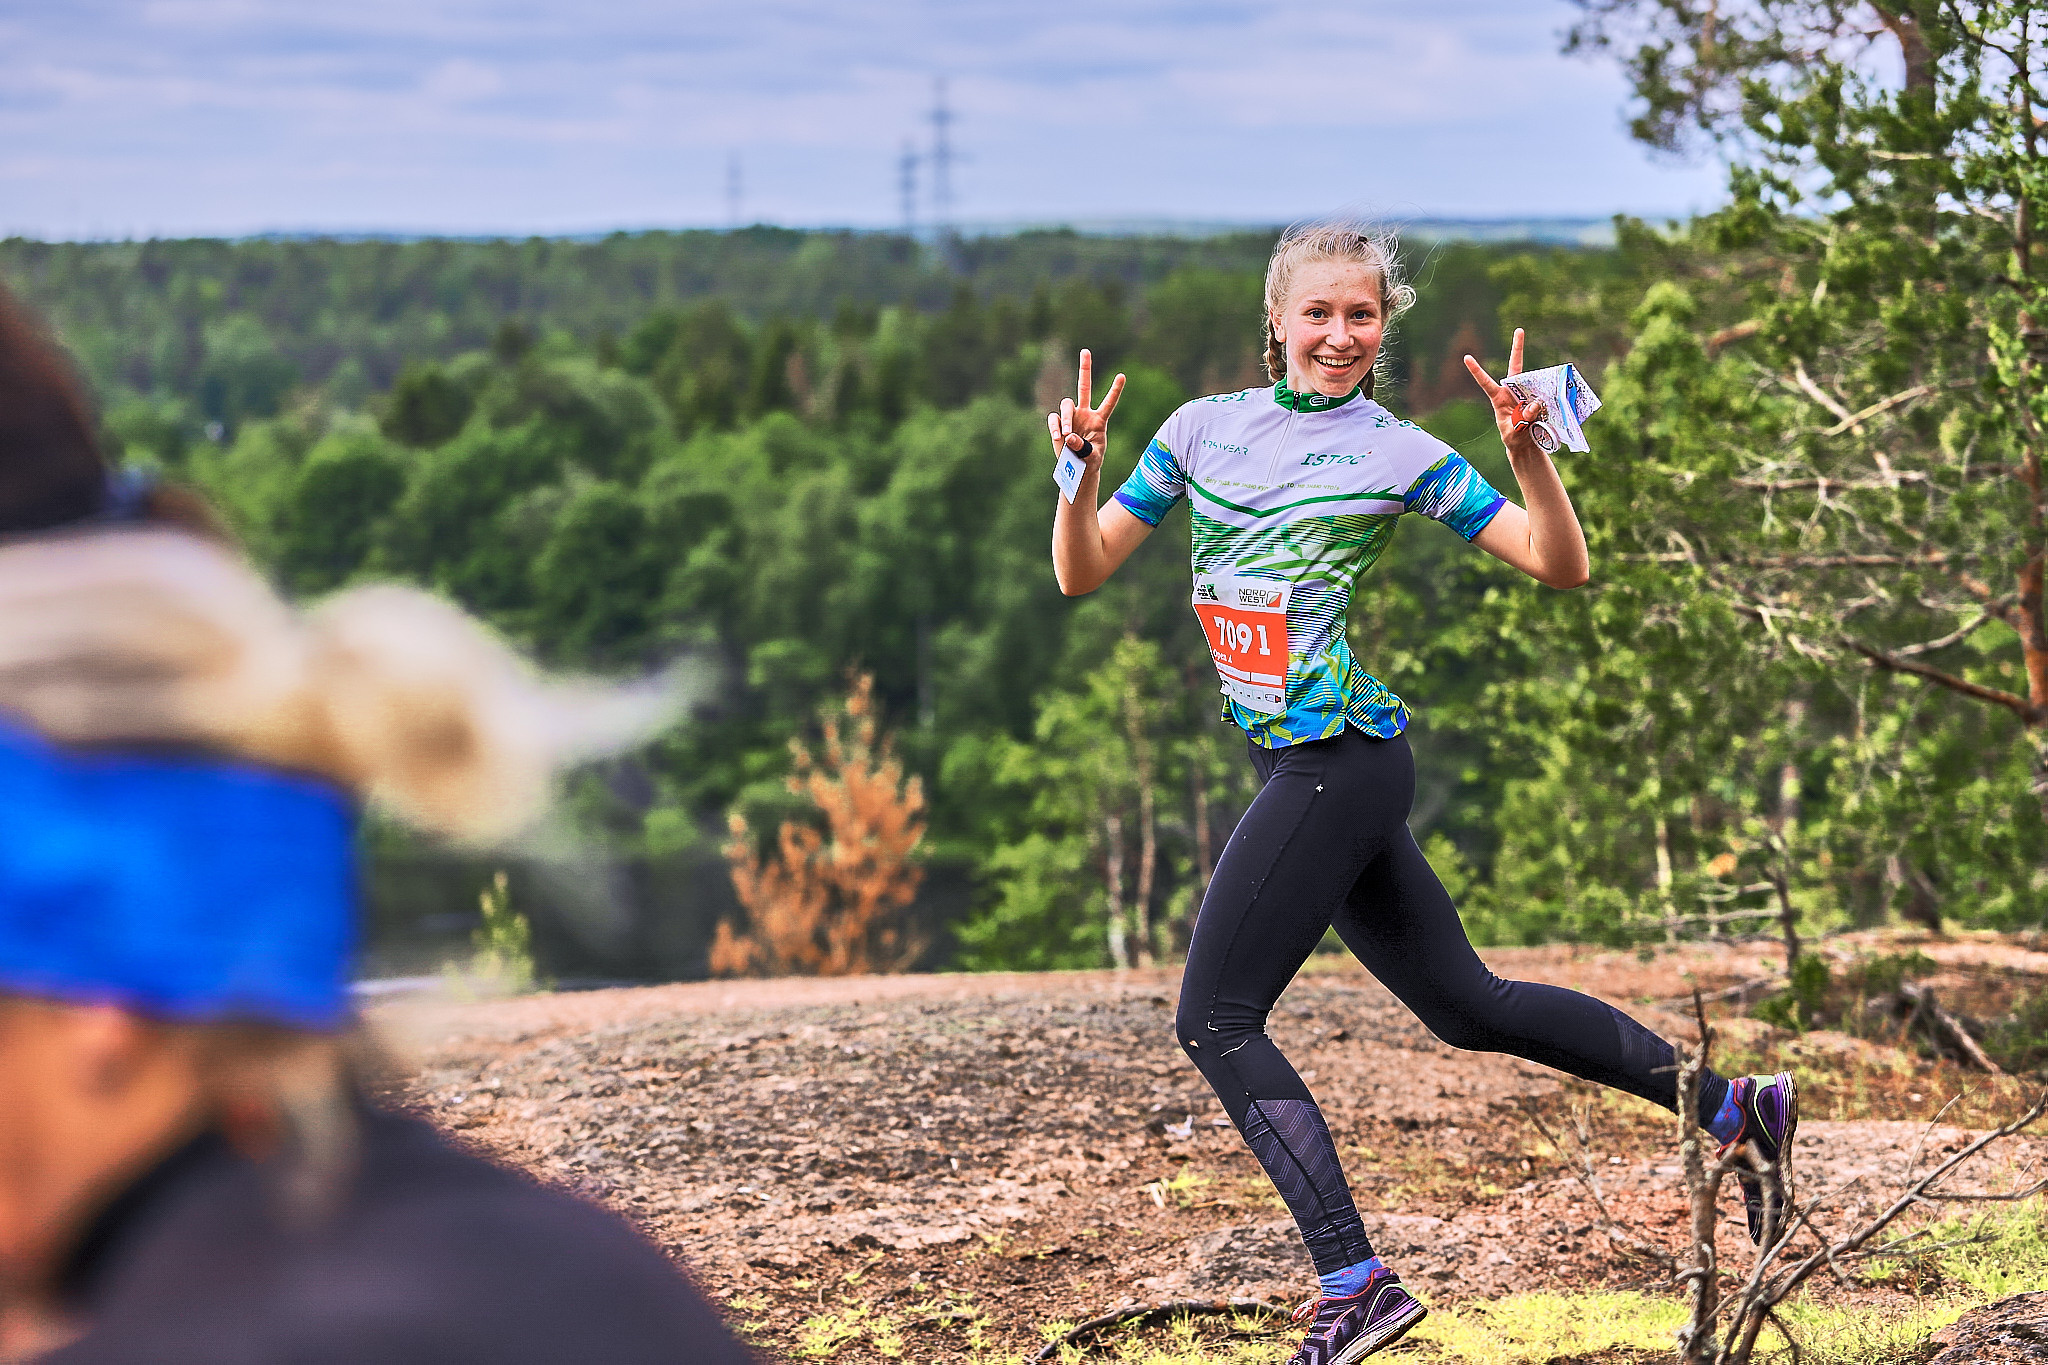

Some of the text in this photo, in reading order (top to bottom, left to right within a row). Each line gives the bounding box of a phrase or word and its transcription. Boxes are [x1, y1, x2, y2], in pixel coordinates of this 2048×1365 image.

[1238, 588, 1267, 597] NORD
[1239, 595, 1266, 604] WEST
[1213, 615, 1271, 656] 7091
